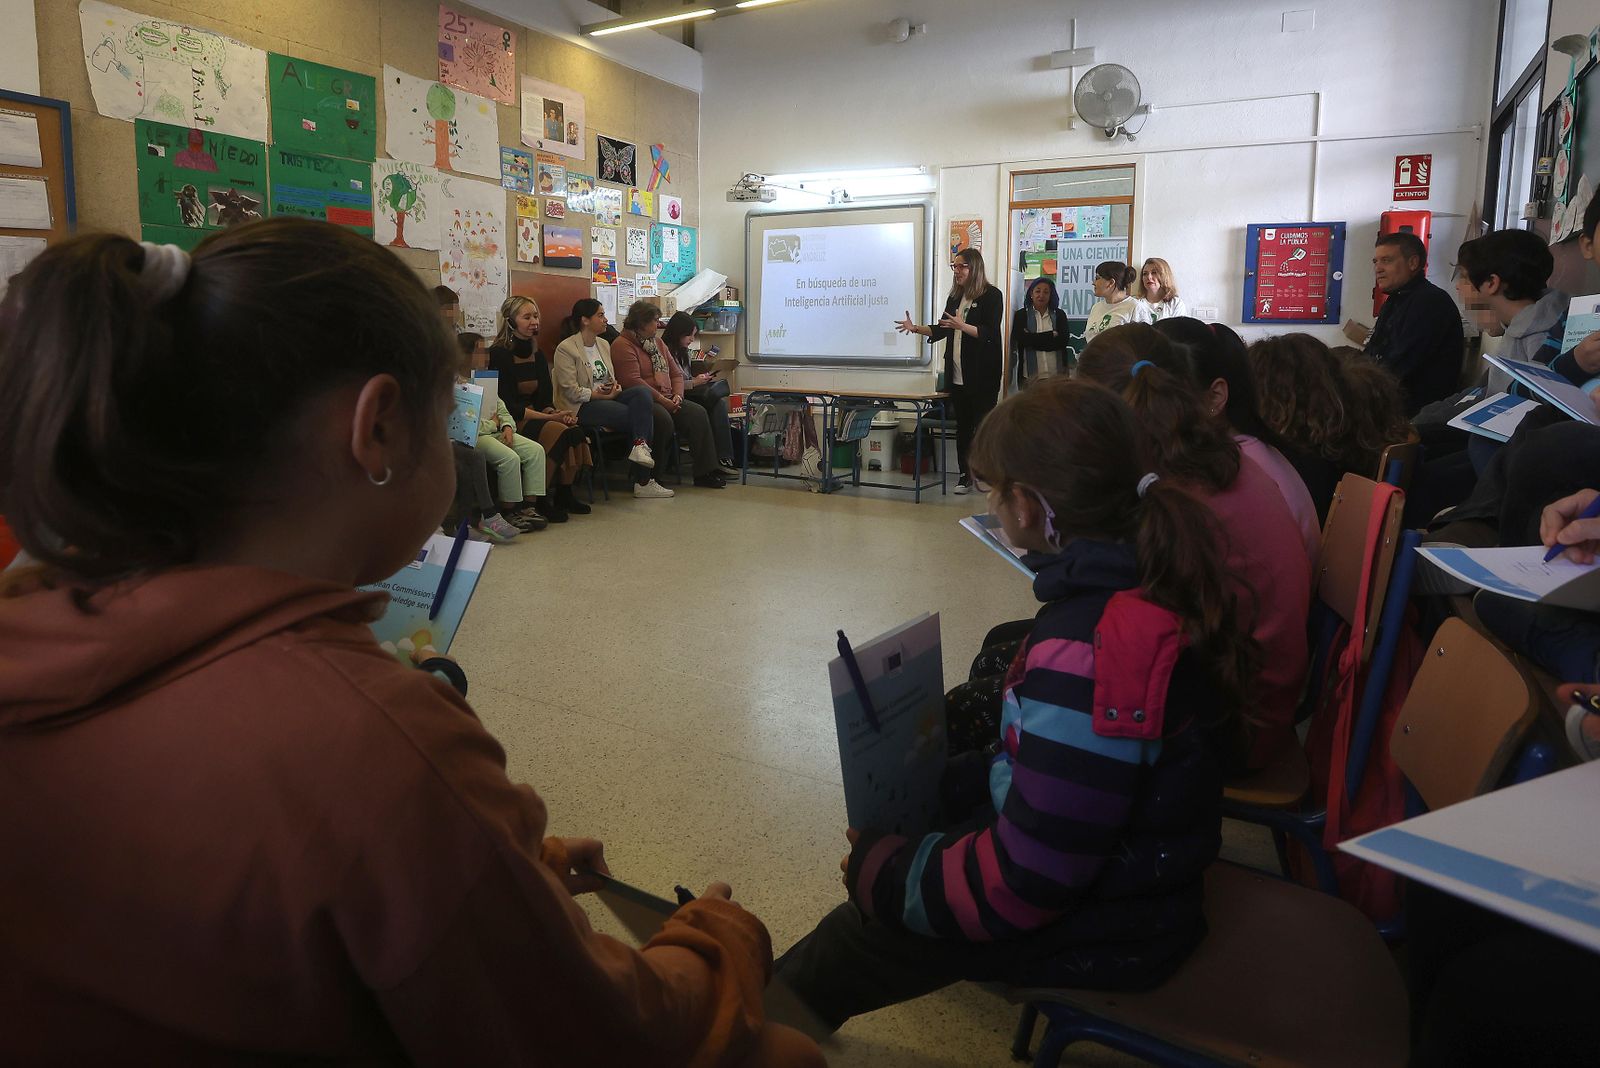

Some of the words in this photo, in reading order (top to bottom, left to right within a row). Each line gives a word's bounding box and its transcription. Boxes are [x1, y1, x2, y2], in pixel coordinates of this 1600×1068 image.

[1395, 190, 1427, 198] EXTINTOR
[1062, 248, 1083, 260] UNA
[1061, 265, 1080, 284] EN
[796, 278, 806, 290] En
[808, 277, 847, 291] búsqueda
[849, 276, 859, 288] de
[861, 277, 877, 288] una
[784, 296, 830, 310] Inteligencia
[831, 294, 867, 307] Artificial
[868, 295, 889, 308] justa
[392, 583, 436, 599] Commission's
